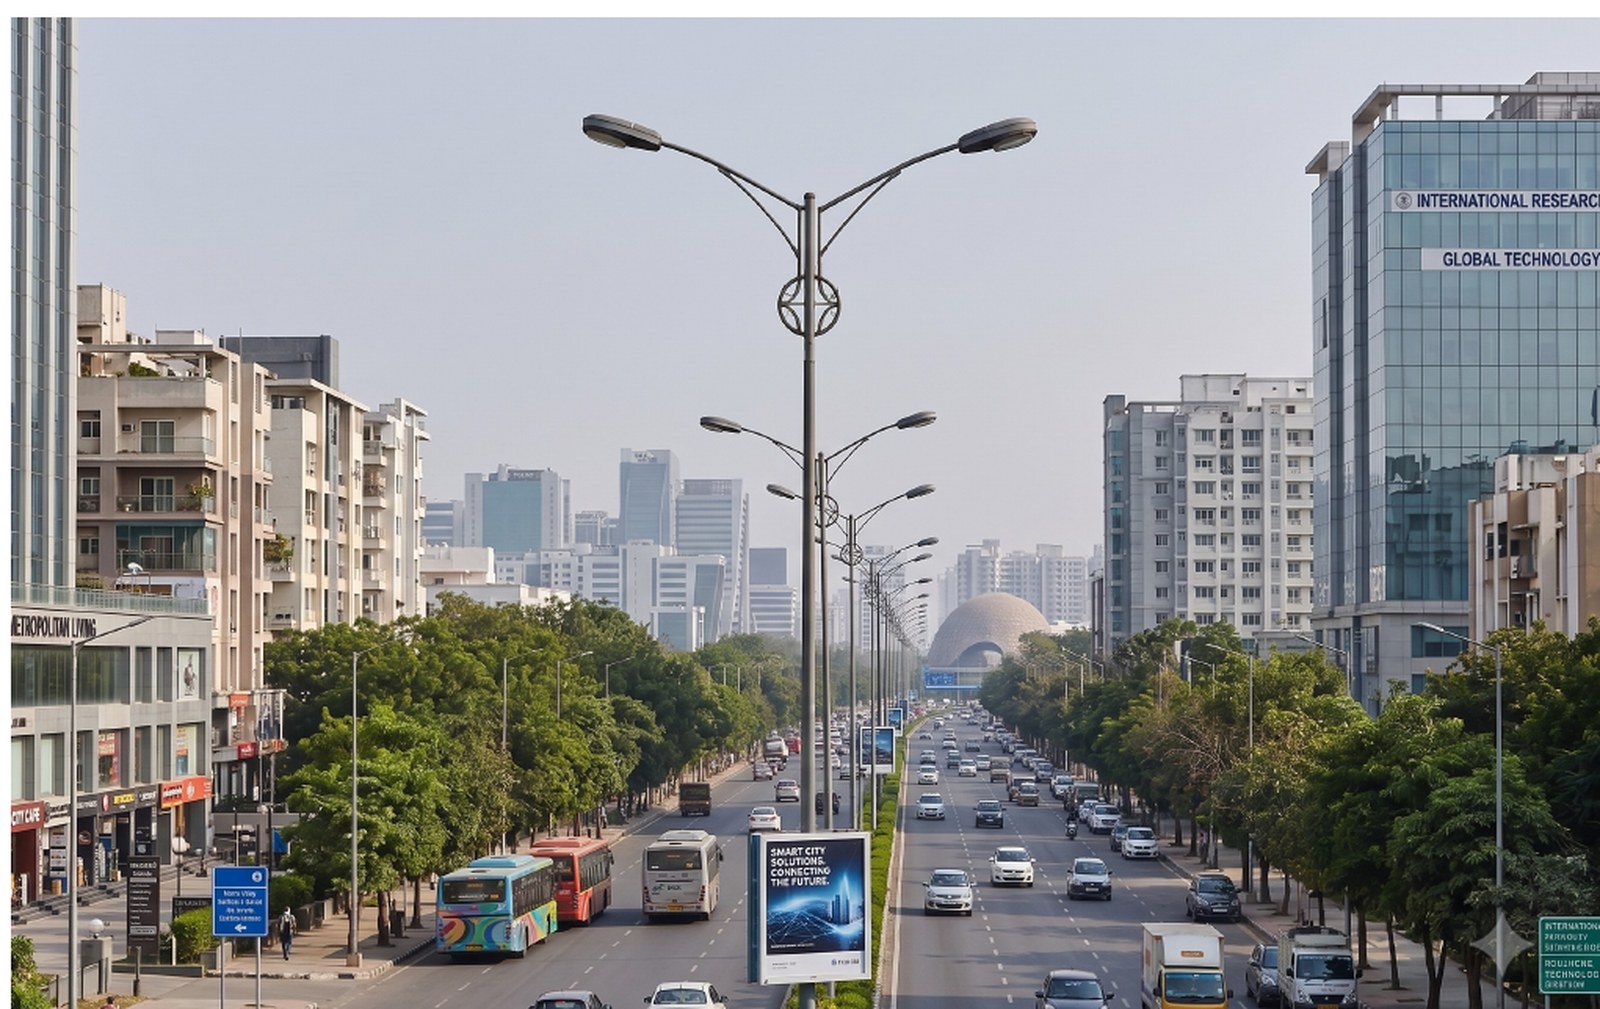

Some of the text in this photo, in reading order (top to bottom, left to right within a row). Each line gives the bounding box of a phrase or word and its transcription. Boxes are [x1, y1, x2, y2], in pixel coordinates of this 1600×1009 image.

[1417, 193, 1600, 208] INTERNATIONAL RESEARC
[1443, 252, 1600, 267] GLOBAL TECHNOLOGY
[770, 846, 826, 857] SMART CITY
[770, 866, 831, 876] CONNECTING
[770, 876, 830, 887] THE FUTURE.
[1544, 922, 1600, 930] INTERNATION
